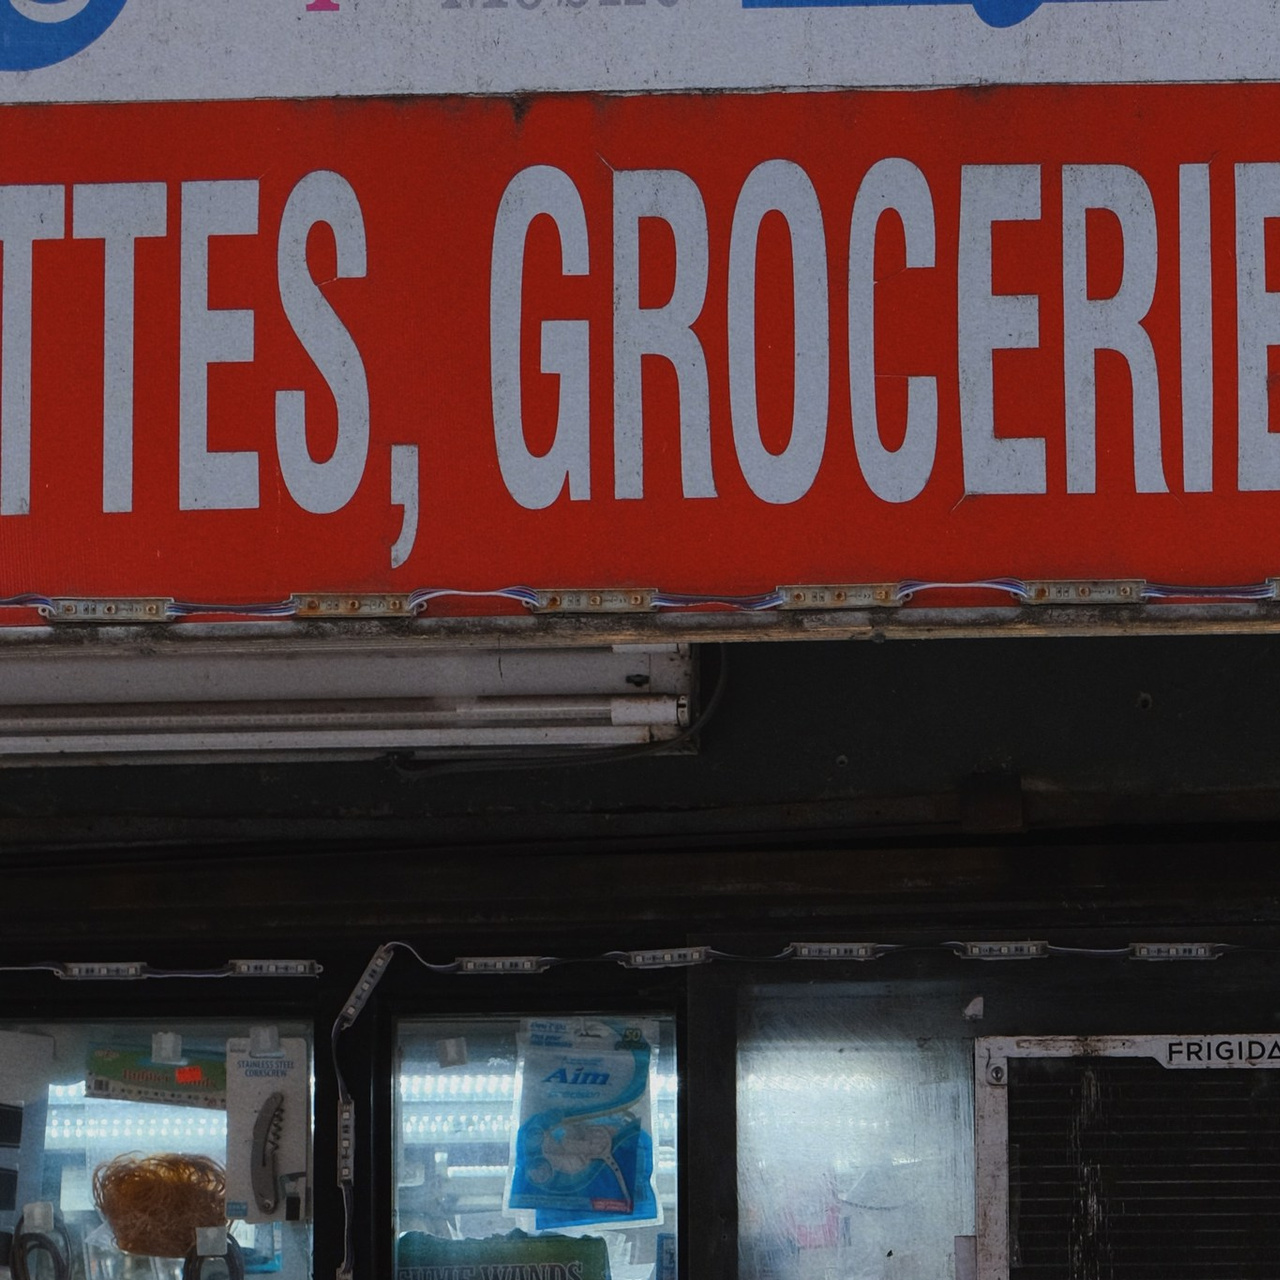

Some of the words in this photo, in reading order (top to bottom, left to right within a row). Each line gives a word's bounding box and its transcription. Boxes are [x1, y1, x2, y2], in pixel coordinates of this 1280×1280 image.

[237, 1060, 272, 1069] STAINLESS
[274, 1060, 295, 1070] STEEL
[542, 1066, 612, 1086] Aim
